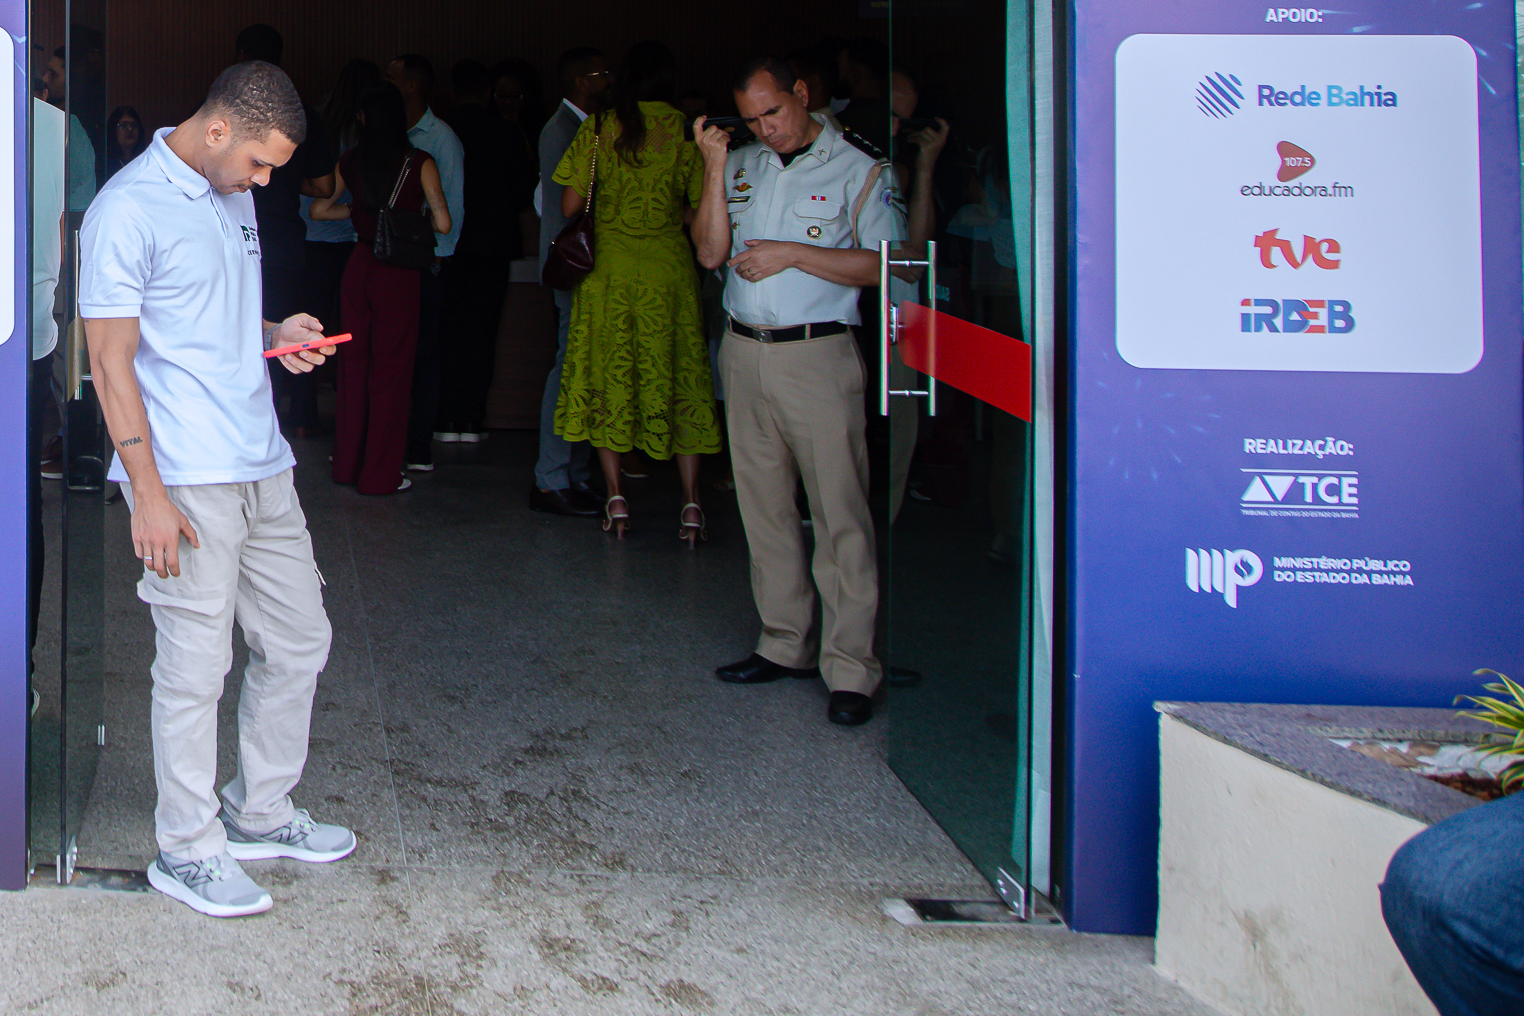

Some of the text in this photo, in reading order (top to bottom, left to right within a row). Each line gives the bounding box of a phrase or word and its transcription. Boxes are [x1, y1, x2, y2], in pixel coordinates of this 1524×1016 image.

[1264, 8, 1323, 24] APOIO:
[1257, 84, 1398, 108] Rede Bahia
[1283, 157, 1312, 167] 107.5
[1240, 182, 1355, 198] educadora.fm
[1253, 227, 1342, 270] tve
[1243, 436, 1355, 459] REALIZAÇÃO:
[1296, 475, 1359, 505] TCE
[1273, 555, 1411, 572] MINISTÉRIO PÚBLICO
[1273, 570, 1415, 587] DO ESTADO DA BAHIA
